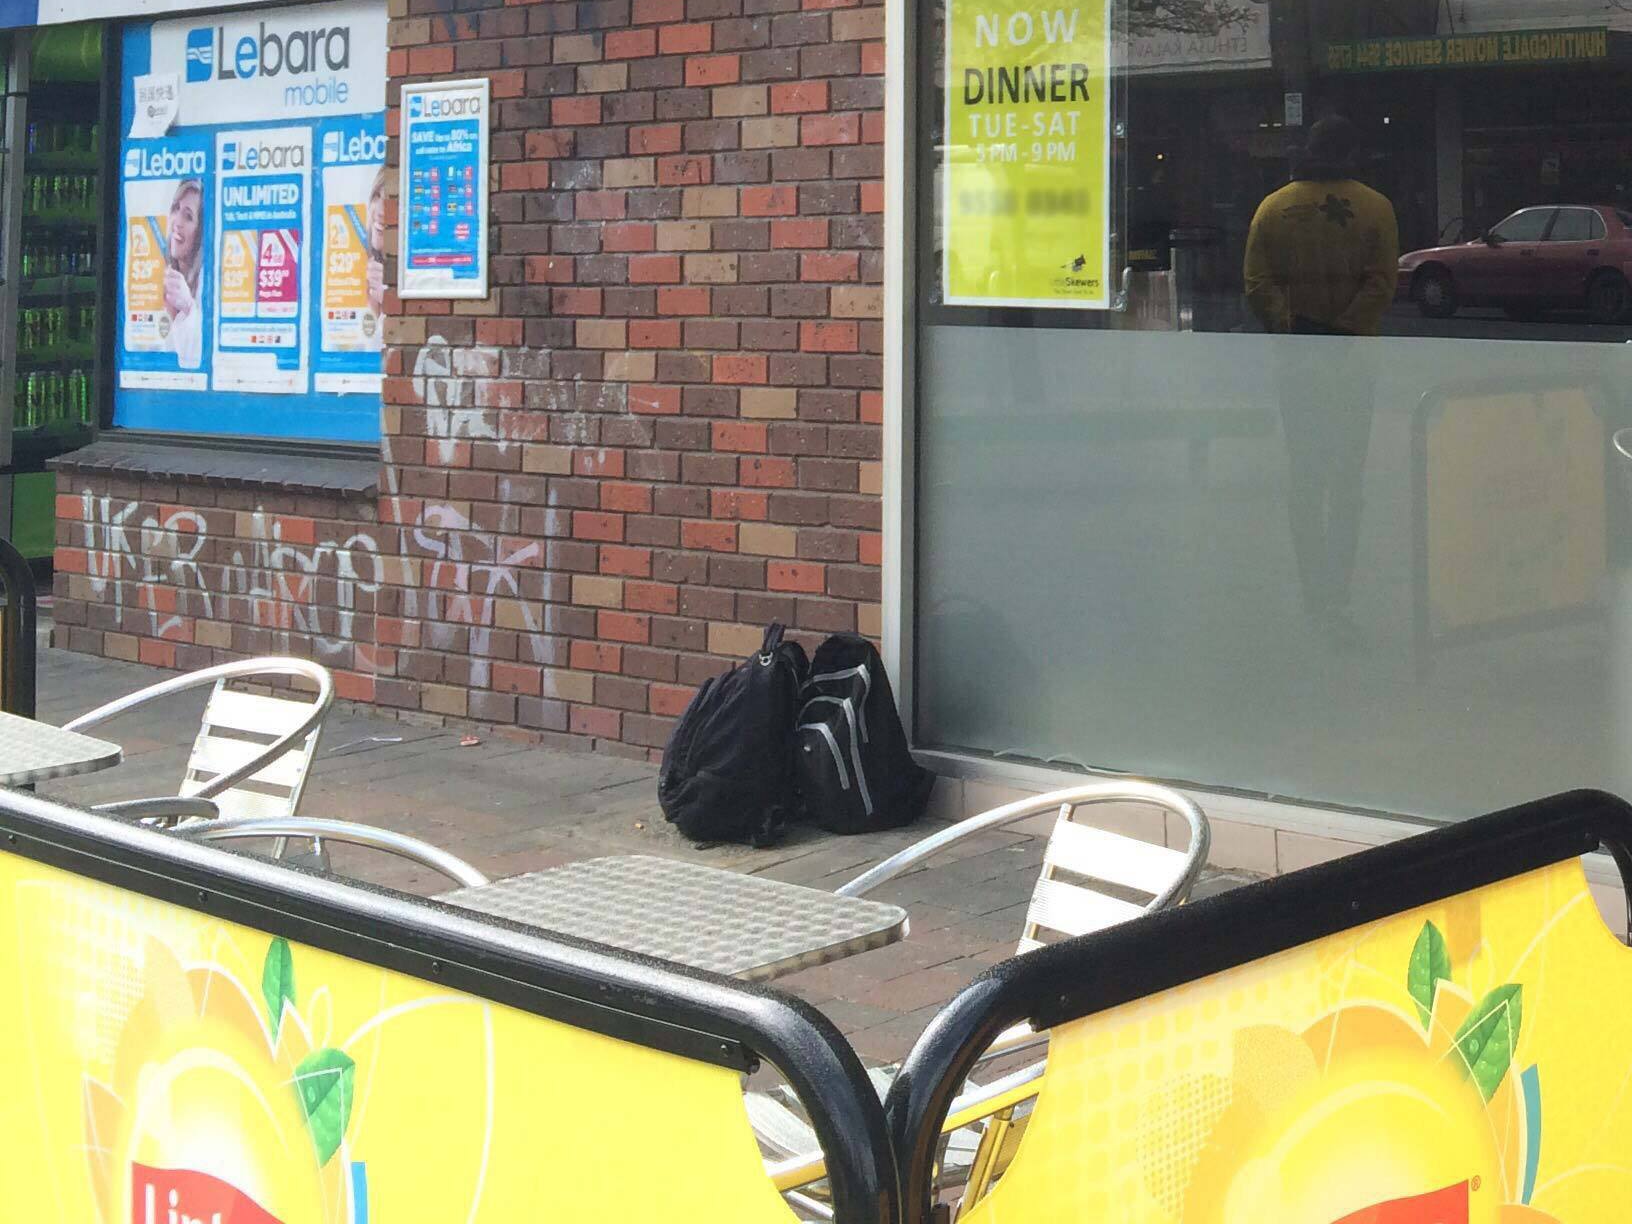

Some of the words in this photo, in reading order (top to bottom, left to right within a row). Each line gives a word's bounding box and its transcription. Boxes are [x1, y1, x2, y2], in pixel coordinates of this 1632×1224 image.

[975, 8, 1079, 48] NOW
[218, 21, 350, 80] Lebara
[284, 77, 349, 107] mobile
[964, 63, 1090, 105] DINNER
[423, 96, 481, 118] Lebara
[142, 147, 206, 177] Lebara
[237, 141, 305, 170] Lebara
[1031, 142, 1042, 162] 9
[1047, 141, 1076, 162] PM
[222, 183, 299, 207] UNLIMITED
